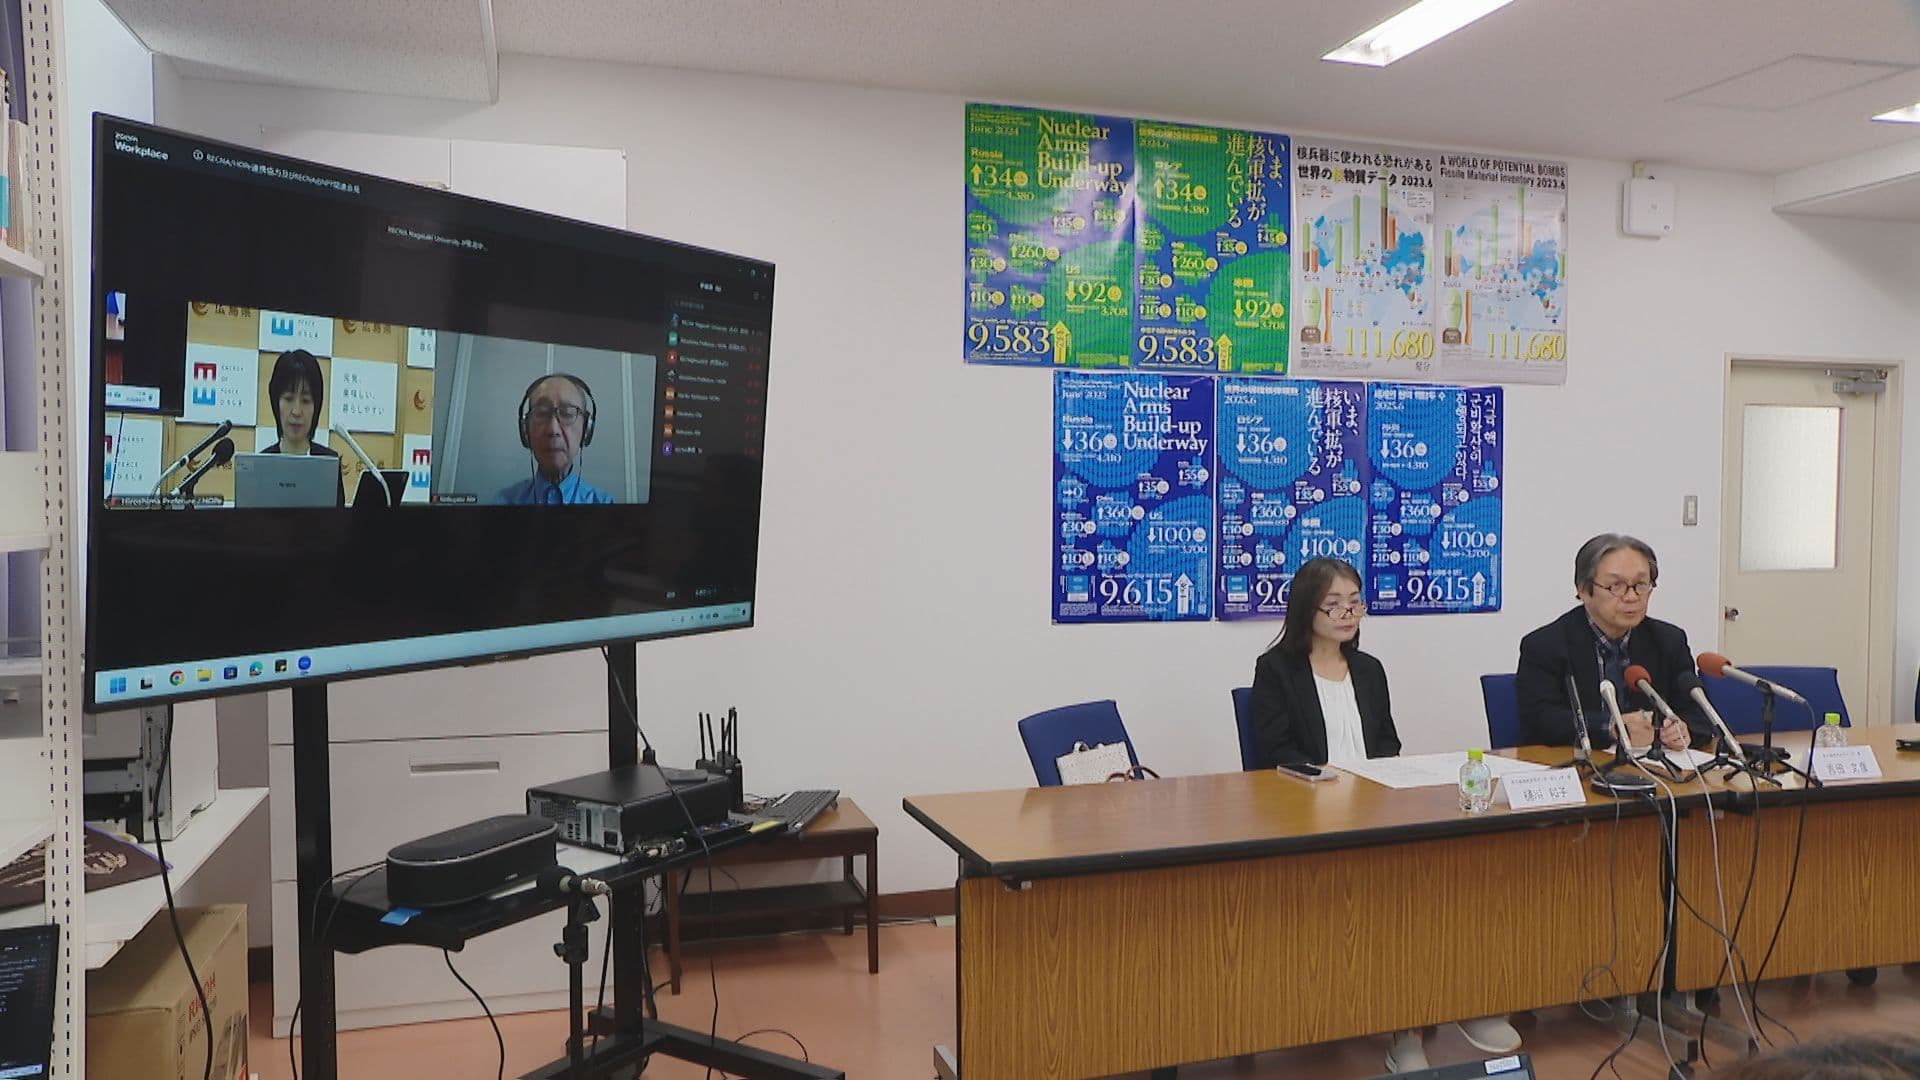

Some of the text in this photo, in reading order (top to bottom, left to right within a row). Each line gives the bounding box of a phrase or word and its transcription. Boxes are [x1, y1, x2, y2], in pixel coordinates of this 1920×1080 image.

[1038, 116, 1110, 140] Nuclear
[114, 141, 169, 160] Workplace
[1038, 133, 1089, 154] Arms
[1037, 151, 1123, 180] Build-up
[1267, 139, 1286, 189] いま、
[1297, 146, 1433, 172] 核兵器に使われる恐れがある
[1440, 155, 1566, 178] A WORLD OF POTENTIAL BOMBS
[1037, 170, 1129, 198] Underway
[1226, 133, 1245, 228] 進んでいる
[1246, 136, 1267, 221] 核軍拡が
[1440, 168, 1465, 179] Fissile
[1466, 170, 1498, 182] Material
[1079, 281, 1106, 303] 92
[1245, 299, 1271, 319] 92
[1344, 327, 1434, 362] 111,680
[1487, 331, 1567, 363] 111,680
[1123, 381, 1190, 401] Nuclear
[1123, 397, 1171, 414] Arms
[1344, 389, 1360, 436] いま、
[1484, 393, 1496, 427] 지금
[1123, 415, 1202, 438] Build-up
[1237, 415, 1263, 424] ロシア
[1305, 387, 1323, 475] 進んでいる
[1325, 388, 1343, 468] 核軍拡が
[1123, 433, 1208, 455] Underway
